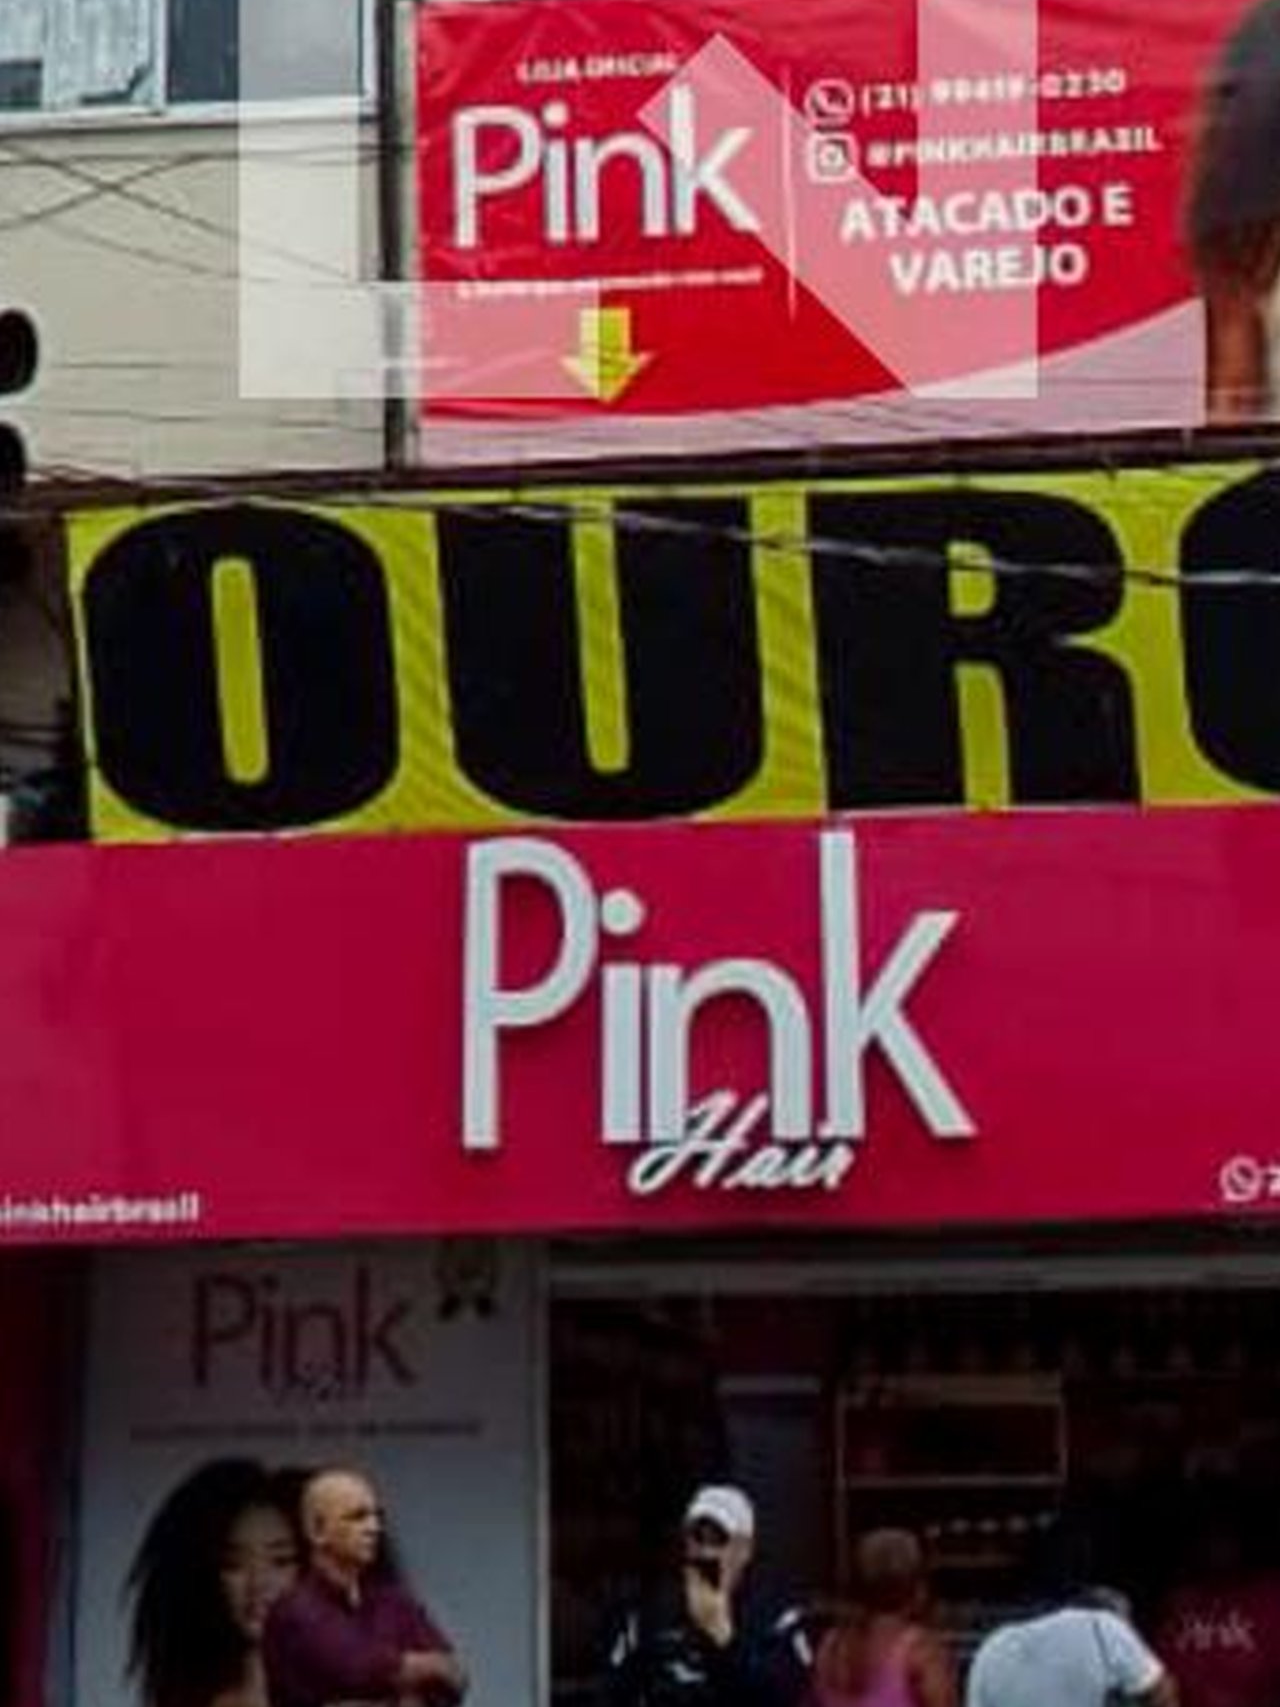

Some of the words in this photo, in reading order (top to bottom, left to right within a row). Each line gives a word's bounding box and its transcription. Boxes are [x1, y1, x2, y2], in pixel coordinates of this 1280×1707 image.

[930, 68, 1127, 105] 99419-0230
[452, 83, 763, 250] Pink
[841, 185, 1093, 244] ATACADO
[1102, 181, 1136, 227] E
[889, 242, 1090, 296] VAREJO
[462, 829, 978, 1151] Pink
[629, 1088, 857, 1195] Hair
[190, 1264, 418, 1390] Pink
